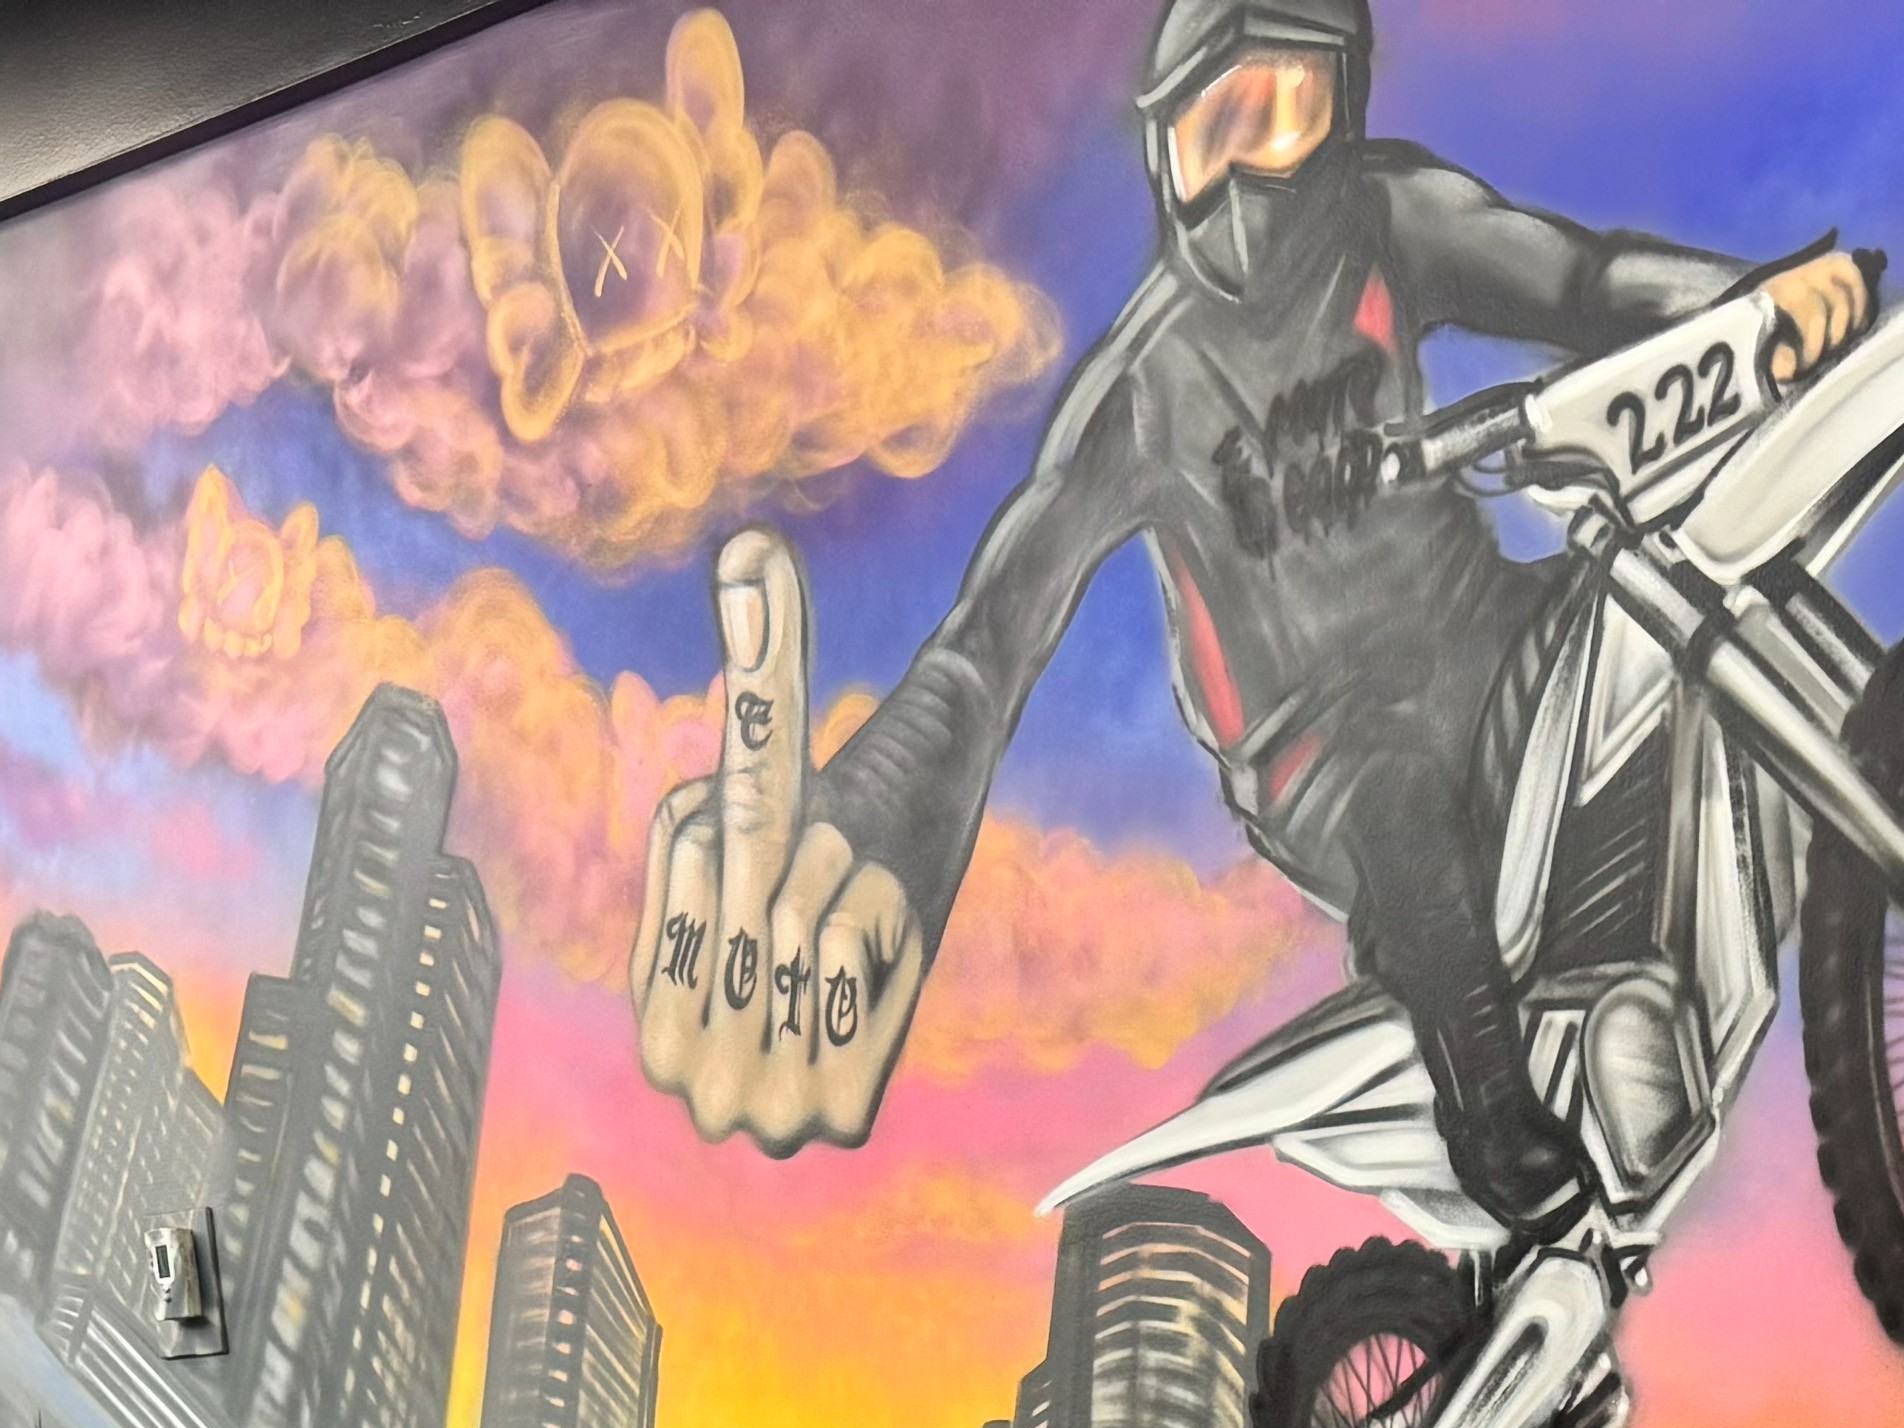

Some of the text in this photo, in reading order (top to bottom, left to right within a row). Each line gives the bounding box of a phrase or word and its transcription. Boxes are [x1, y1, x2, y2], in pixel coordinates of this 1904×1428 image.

[1606, 341, 1742, 475] 222
[735, 690, 774, 752] E
[662, 911, 858, 1048] MOTO
